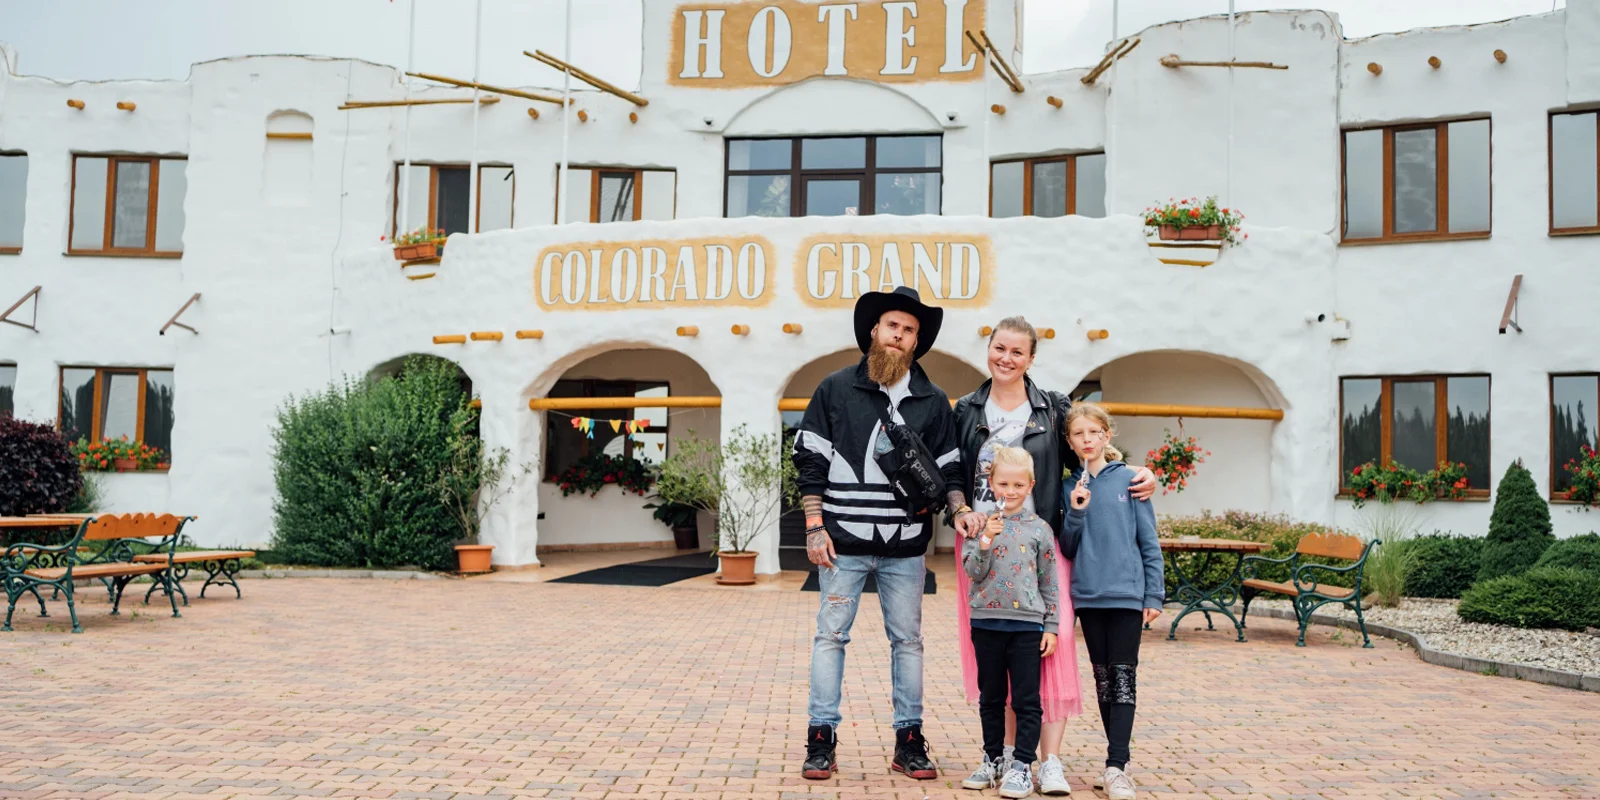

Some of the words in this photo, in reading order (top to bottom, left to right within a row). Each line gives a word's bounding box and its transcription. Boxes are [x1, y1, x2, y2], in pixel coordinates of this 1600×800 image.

[678, 0, 978, 79] HOTEL
[539, 241, 767, 305] COLORADO
[805, 241, 982, 300] GRAND
